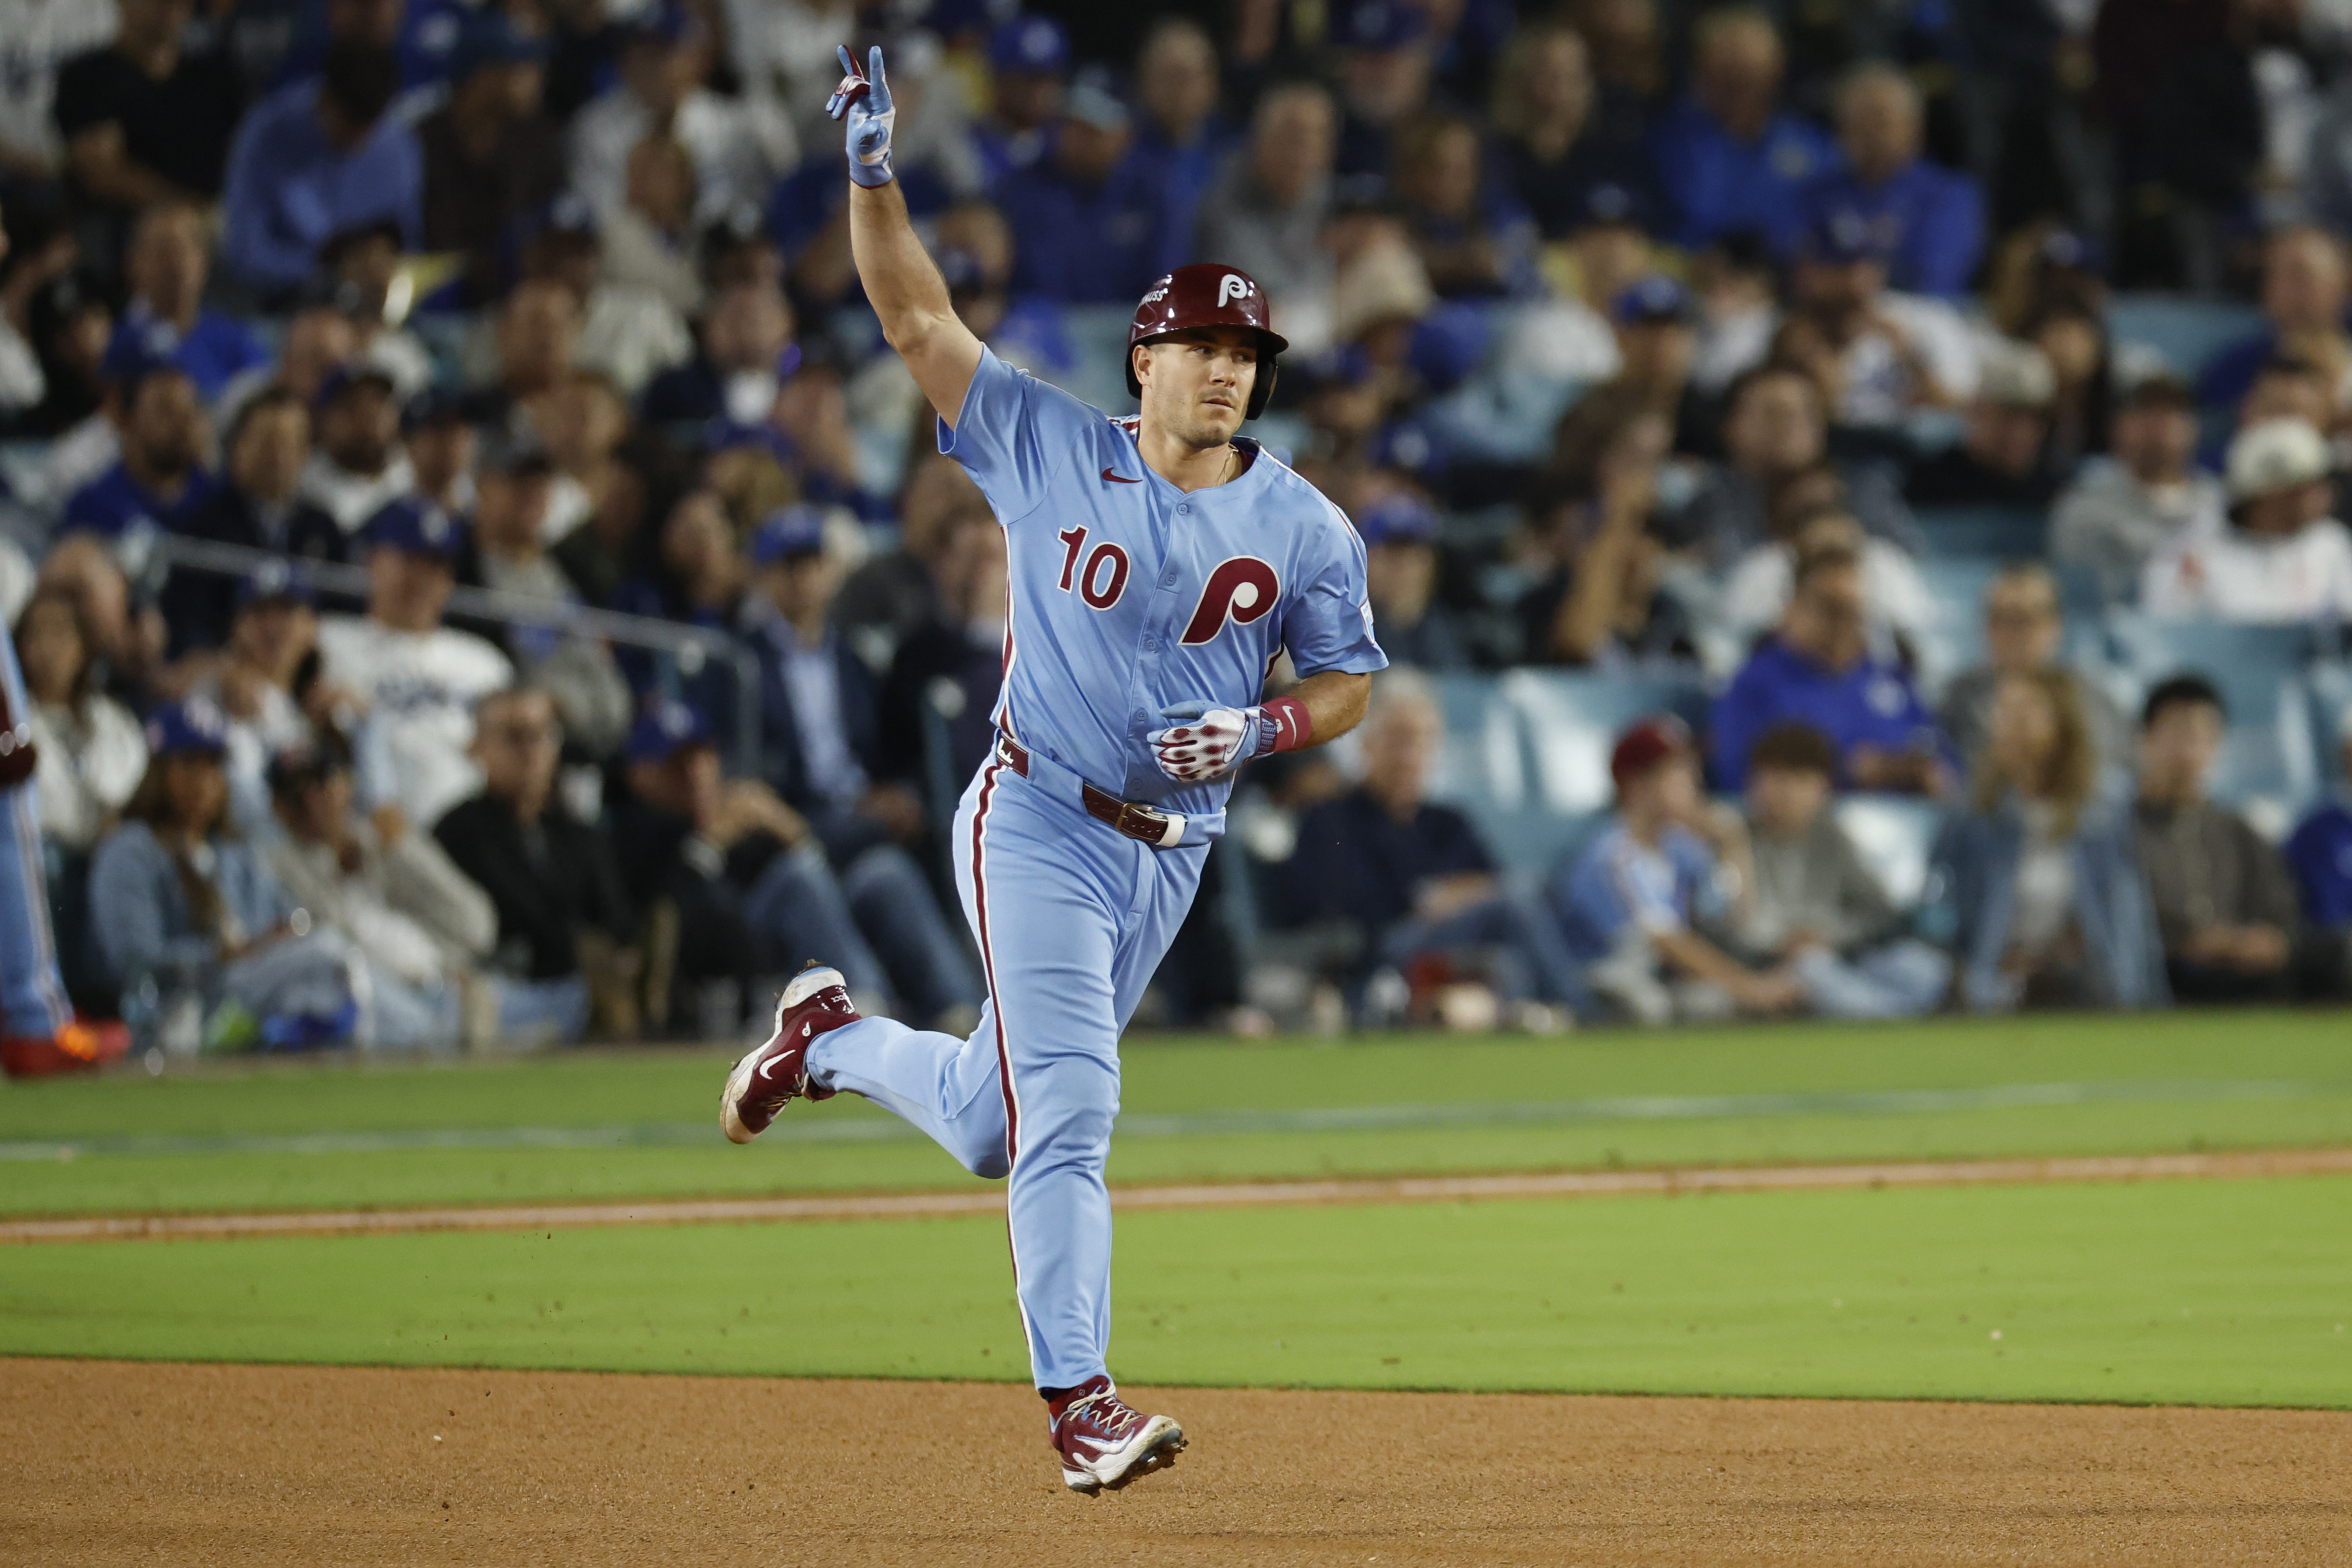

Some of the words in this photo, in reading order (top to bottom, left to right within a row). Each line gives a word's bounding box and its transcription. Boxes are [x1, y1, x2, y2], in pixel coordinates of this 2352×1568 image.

[1217, 273, 1247, 307] P
[1057, 524, 1130, 611] 10
[1177, 555, 1281, 645] P
